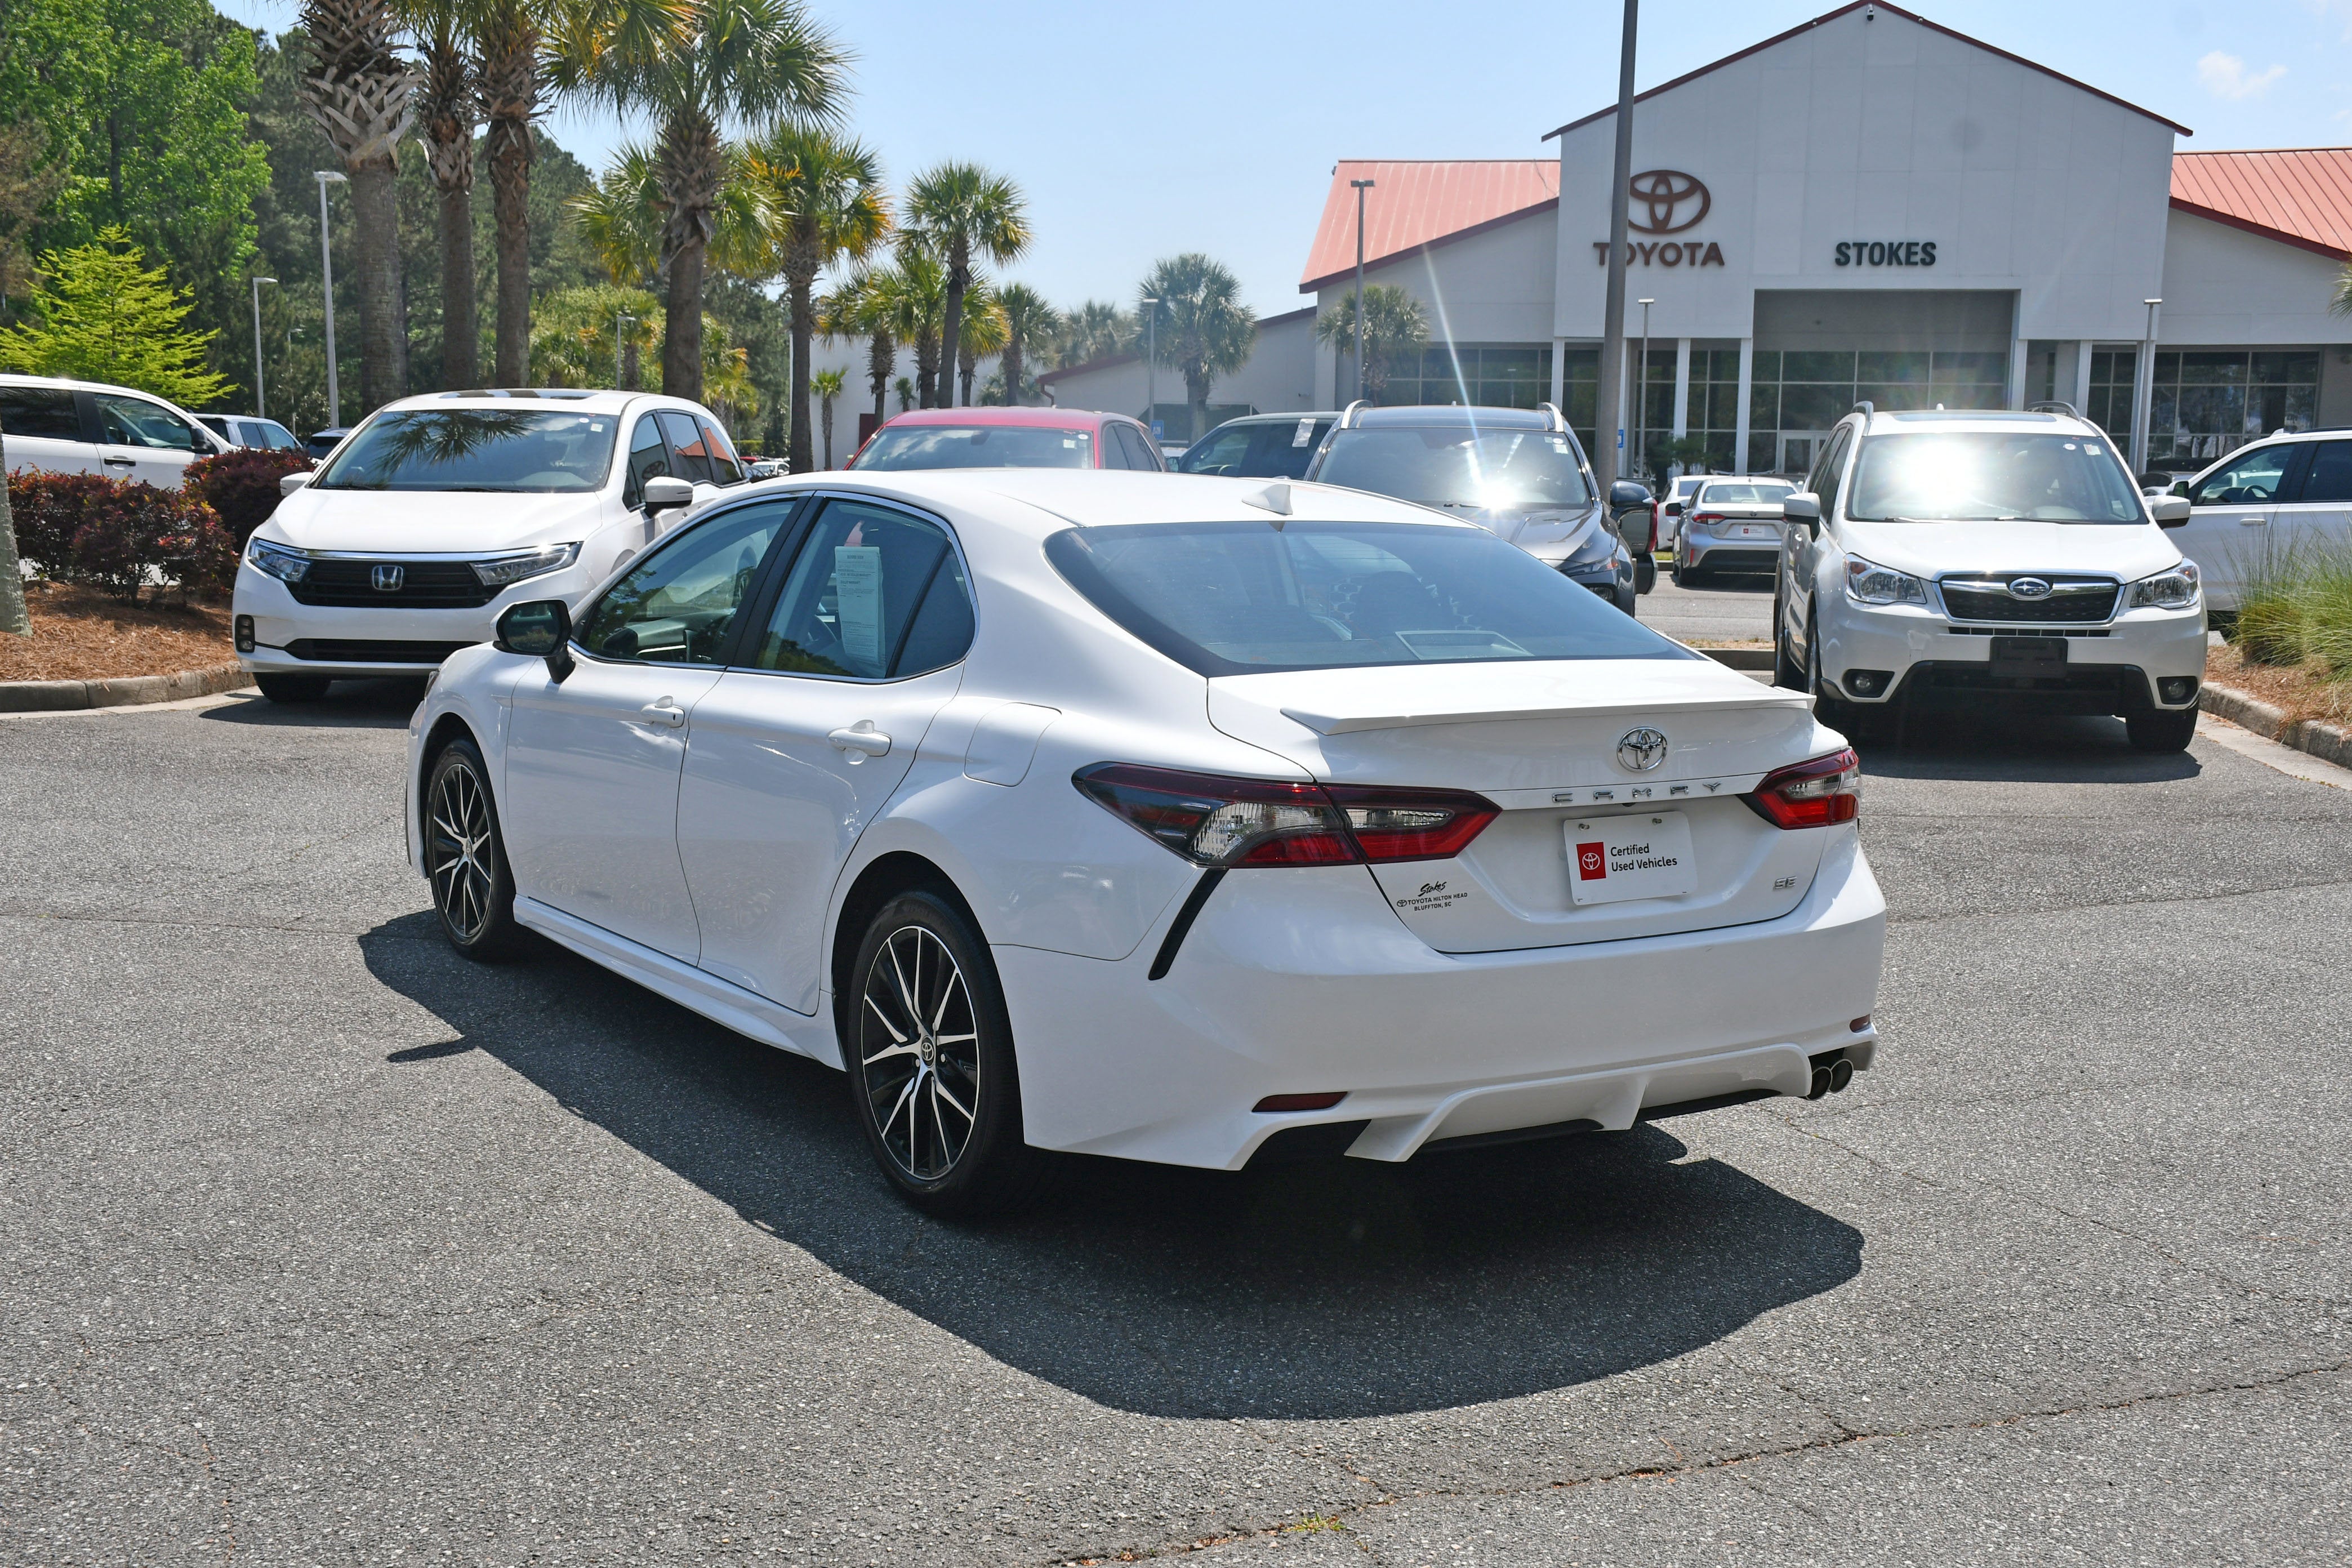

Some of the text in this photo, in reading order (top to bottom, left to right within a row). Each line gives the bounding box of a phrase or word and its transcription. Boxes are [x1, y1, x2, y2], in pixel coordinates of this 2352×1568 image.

[1834, 241, 1937, 266] STOKES
[1552, 782, 1721, 803] CAMRY
[1610, 843, 1650, 857] Certified
[1611, 856, 1678, 872] Used Vehicles
[1418, 881, 1447, 897] Stokes
[1774, 876, 1797, 890] SE
[1414, 902, 1443, 911] BLUFFTON,
